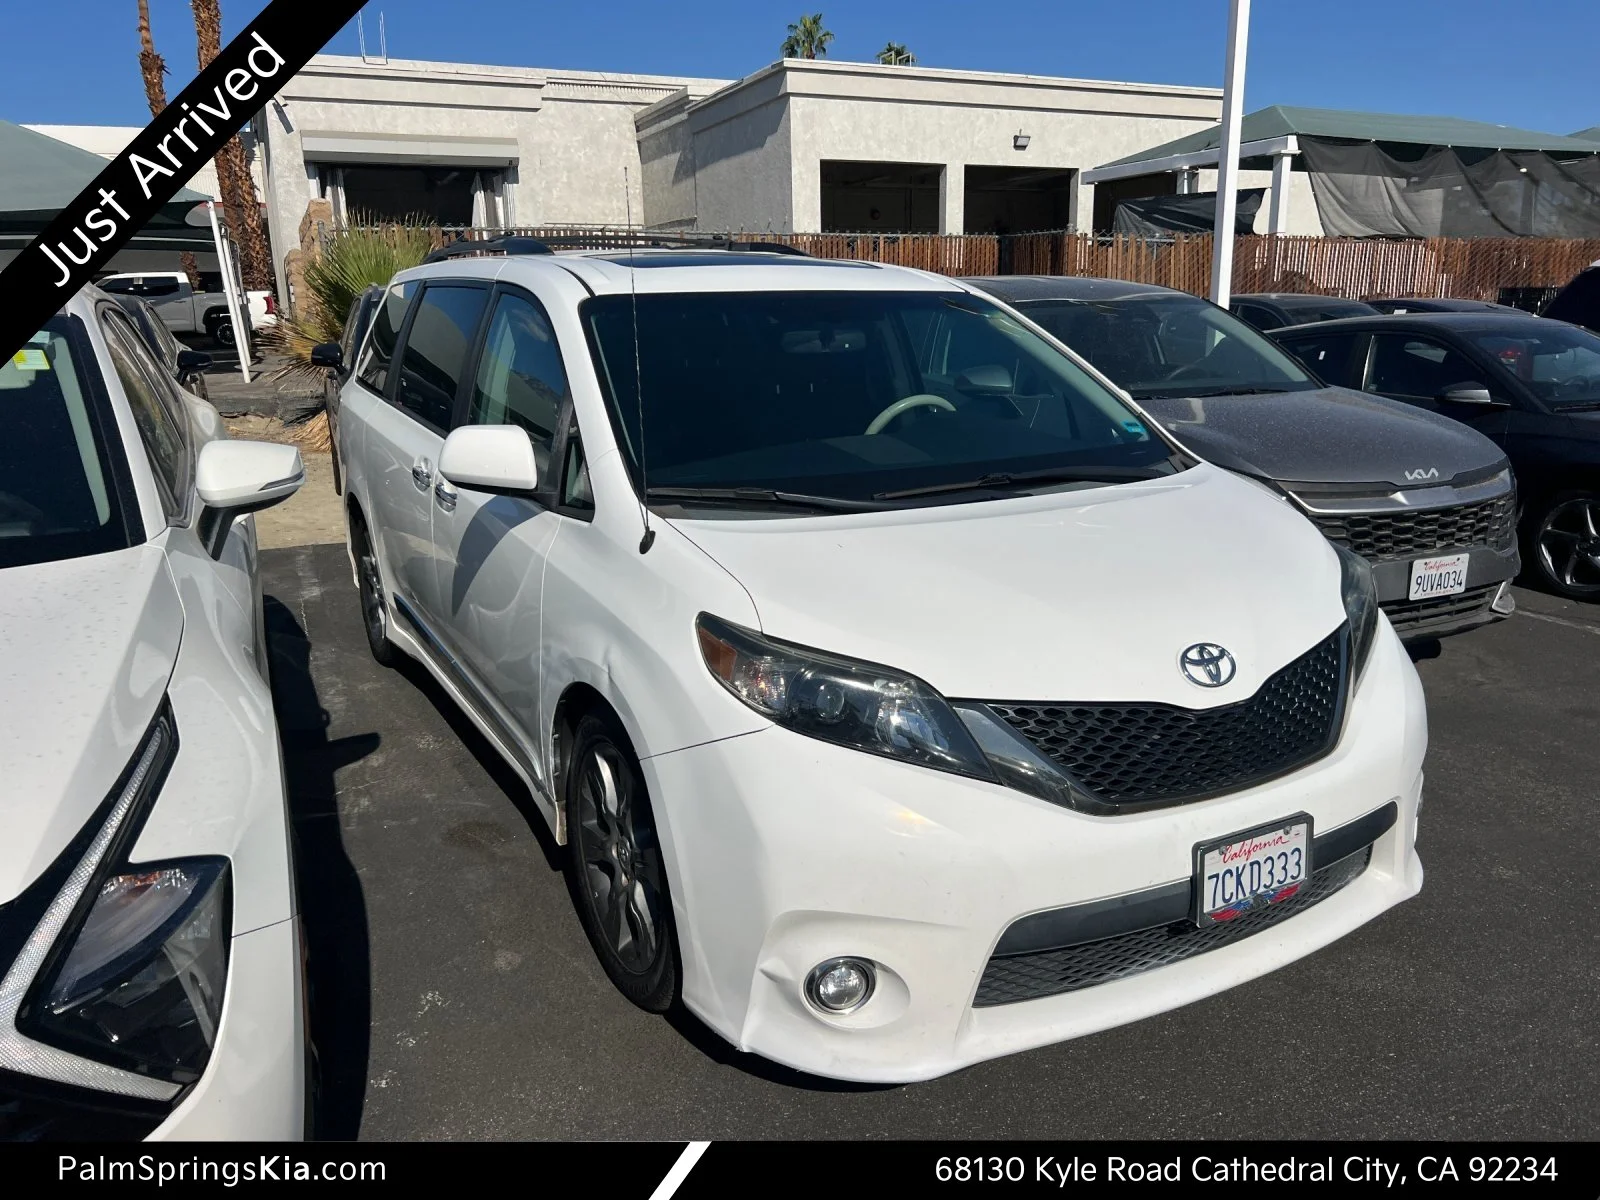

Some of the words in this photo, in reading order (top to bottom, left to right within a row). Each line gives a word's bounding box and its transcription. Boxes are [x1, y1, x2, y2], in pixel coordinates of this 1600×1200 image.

[1424, 560, 1458, 572] California
[1414, 570, 1463, 595] 9UVA034
[1222, 834, 1290, 863] California
[1207, 847, 1302, 908] 7CKD333
